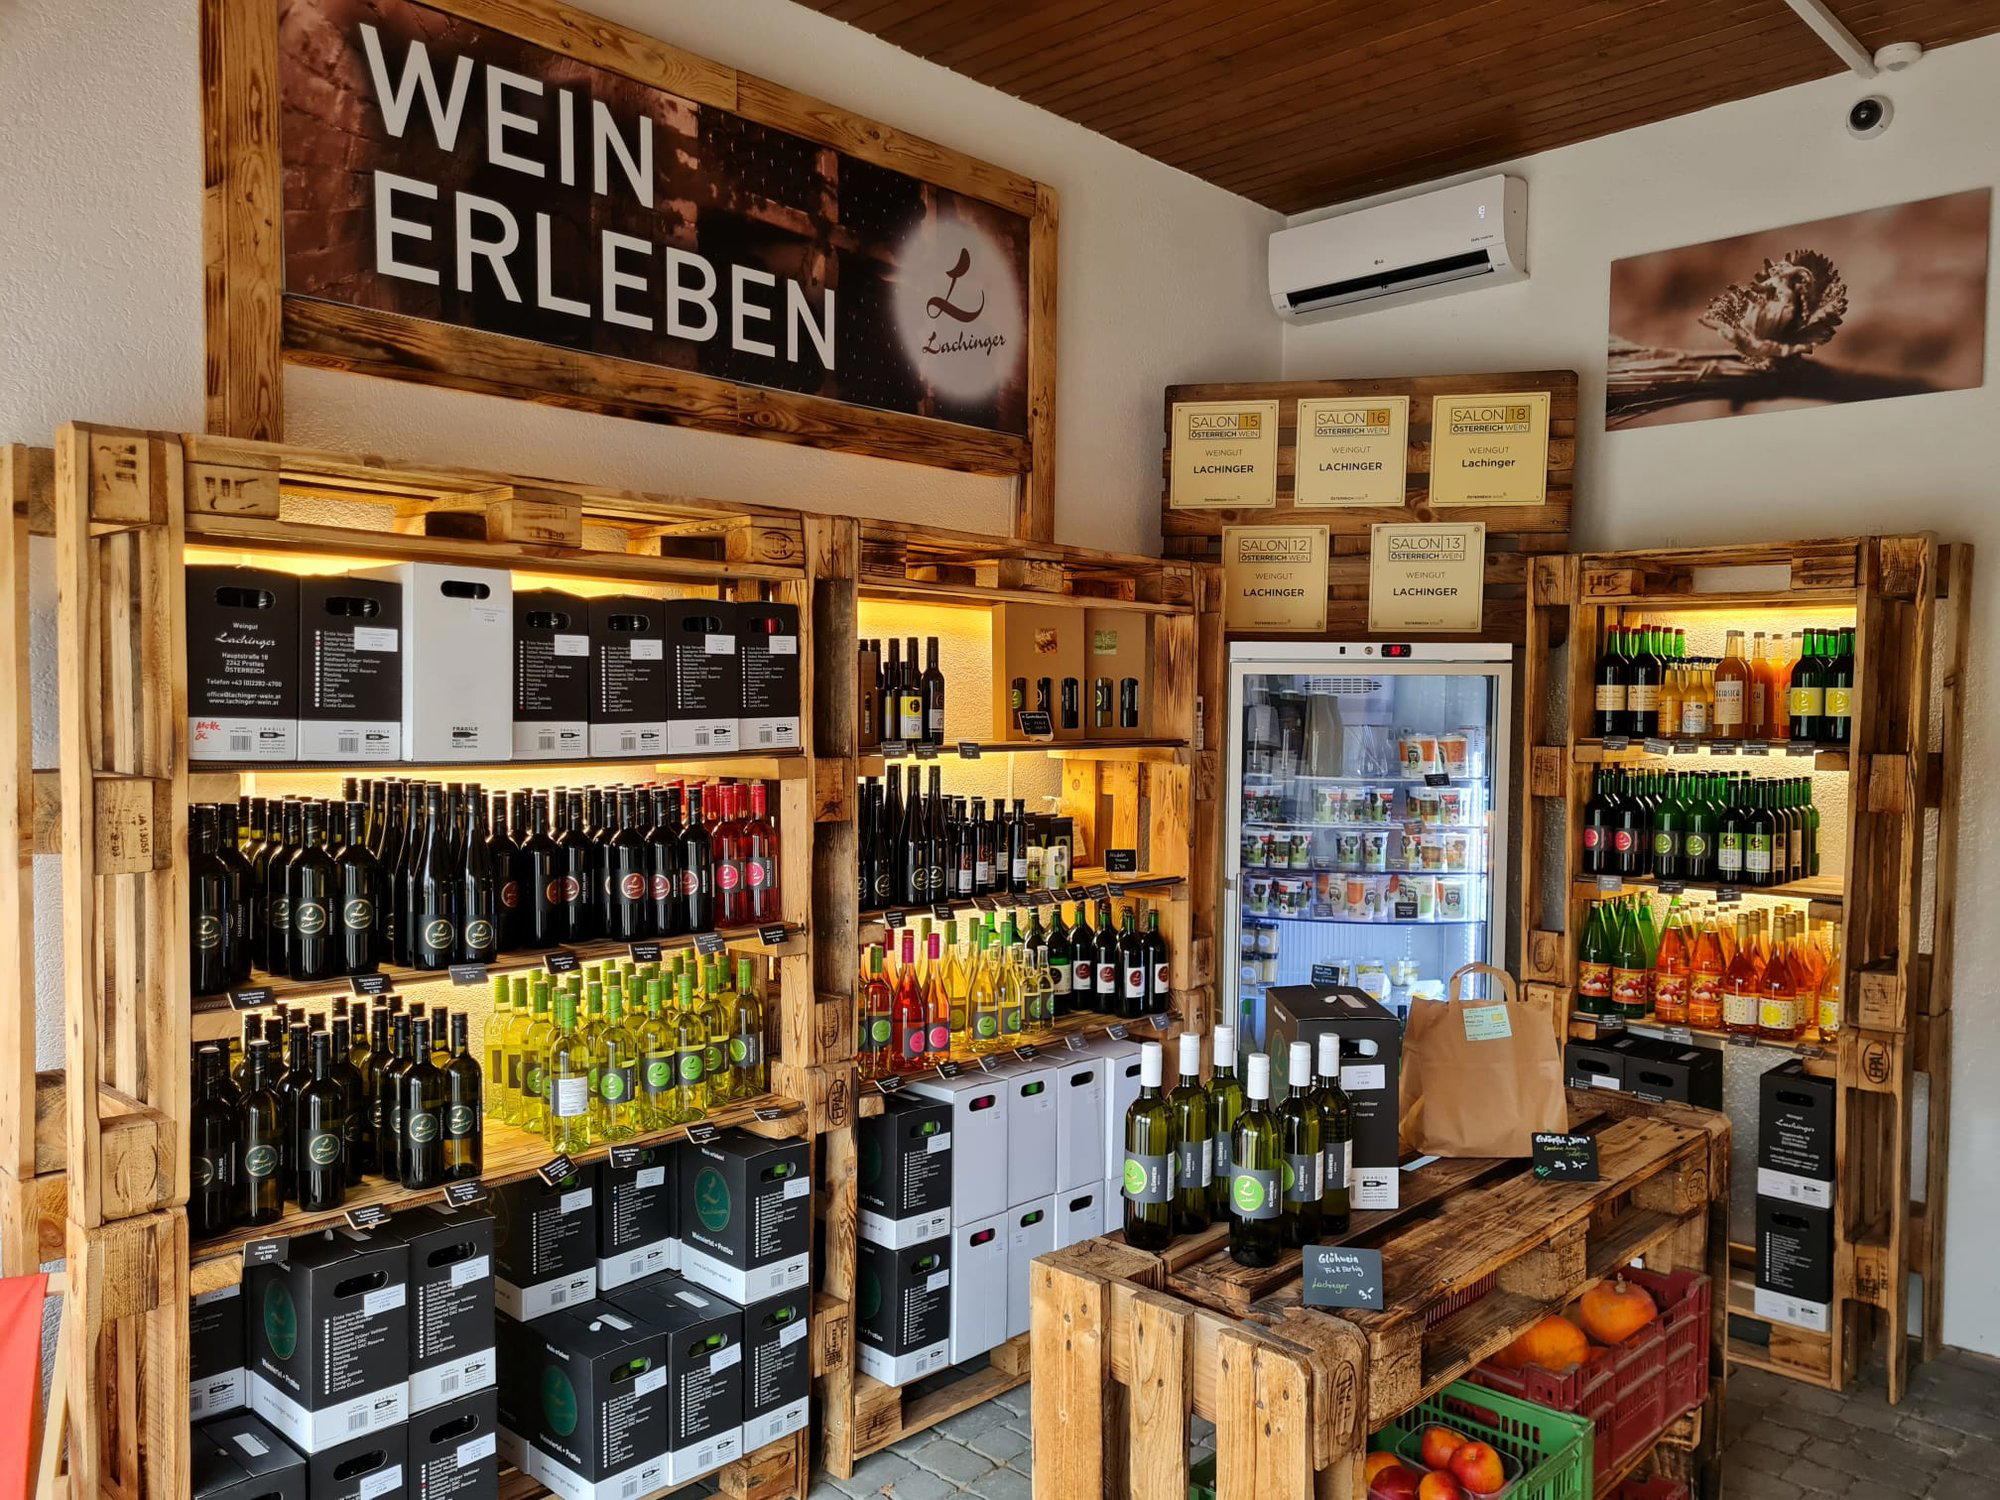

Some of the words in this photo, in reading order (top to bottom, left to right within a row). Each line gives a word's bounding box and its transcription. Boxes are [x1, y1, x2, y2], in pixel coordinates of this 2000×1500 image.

[359, 23, 654, 209] WEIN
[373, 169, 836, 371] ERLEBEN
[922, 331, 1006, 356] Lachinger
[1317, 412, 1364, 425] SALON
[1370, 411, 1386, 424] 16
[1452, 408, 1504, 422] SALON
[1509, 407, 1527, 420] 18
[1191, 415, 1237, 429] SALON
[1243, 415, 1258, 428] 15
[1317, 427, 1365, 436] ÖSTERREICH
[1452, 424, 1503, 434] ÖSTERREICH
[1504, 424, 1528, 432] WEIN
[1191, 430, 1237, 439] ÖSTERREICH
[1238, 430, 1259, 438] WEIN
[1205, 448, 1243, 457] WEINGUT
[1331, 445, 1371, 454] WEINGUT
[1468, 446, 1509, 454] WEINGUT
[1319, 461, 1383, 471] LACHINGER
[1461, 458, 1516, 469] Lachinger
[1193, 464, 1254, 474] LACHINGER
[1241, 539, 1288, 552] SALON
[1292, 538, 1307, 550] 12
[1391, 537, 1440, 551] SALON
[1445, 537, 1461, 550] 13
[1240, 554, 1287, 563] ÖSTERREICH
[1288, 554, 1310, 563] WEIN
[1391, 551, 1439, 561] ÖSTERREICH
[1441, 552, 1464, 560] WEIN
[1255, 572, 1294, 581] WEINGUT
[1405, 570, 1445, 579] WEINGUT
[1243, 587, 1305, 598] LACHINGER
[1393, 587, 1458, 596] LACHINGER
[232, 622, 259, 630] Weingut
[214, 631, 277, 650] Lachinger
[224, 666, 266, 675] ÖSTERREICH
[206, 678, 230, 686] Telefon
[1318, 1252, 1359, 1264] Glühwein
